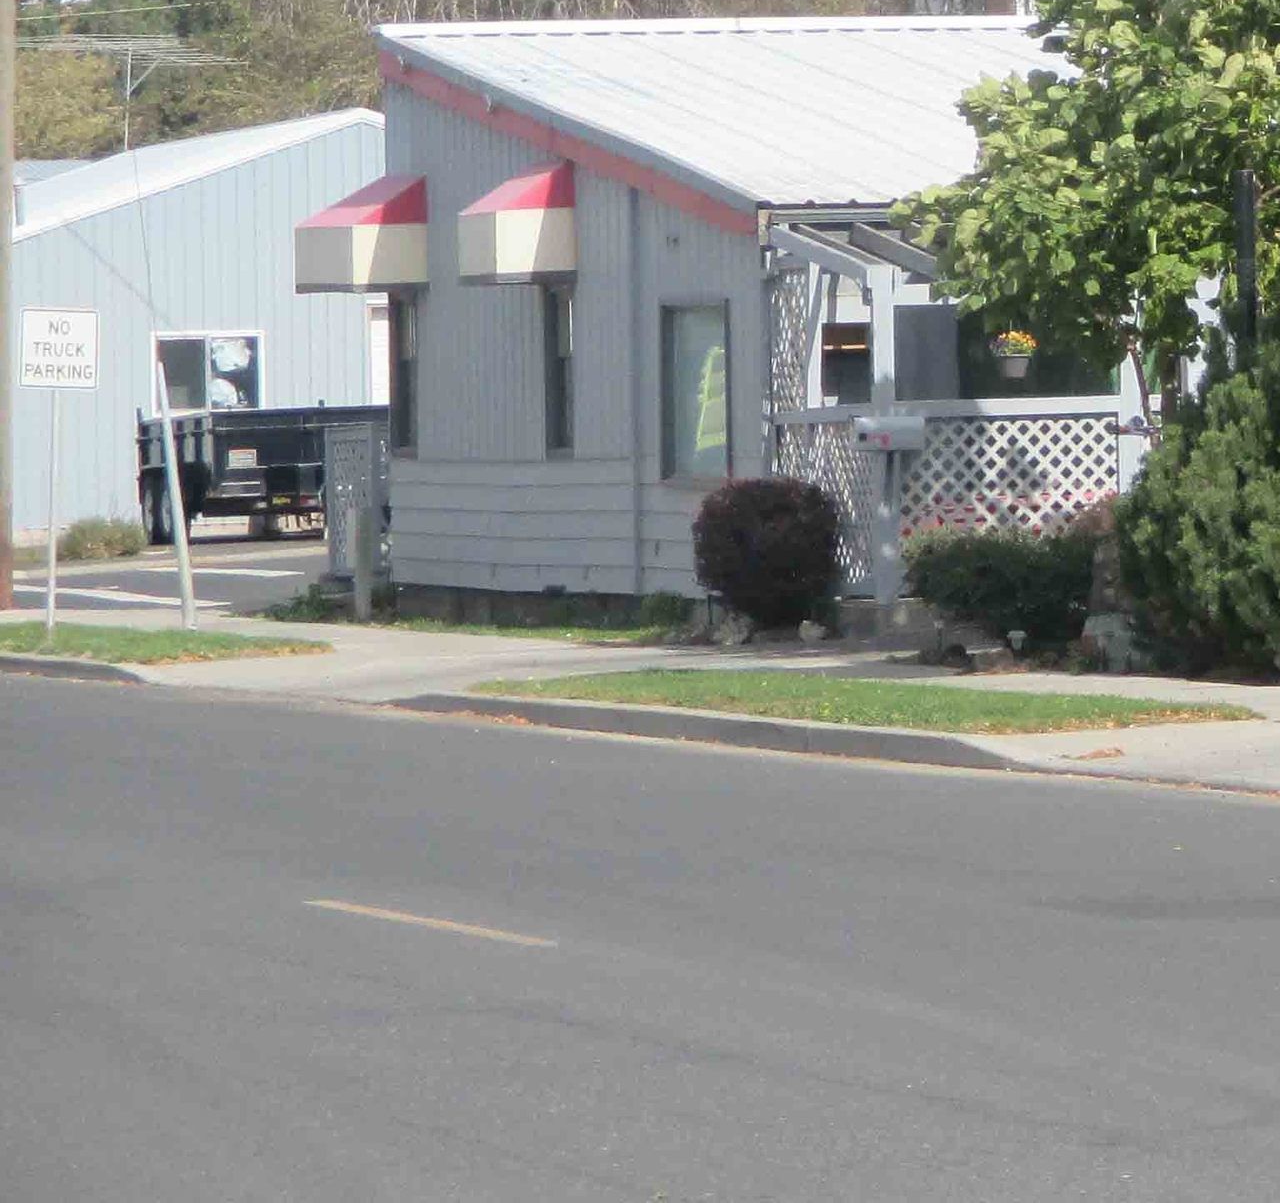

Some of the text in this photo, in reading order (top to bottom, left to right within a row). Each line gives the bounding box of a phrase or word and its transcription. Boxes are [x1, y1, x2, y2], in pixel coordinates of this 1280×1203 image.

[48, 320, 71, 335] NO
[33, 341, 85, 357] TRUCK
[24, 363, 93, 381] PARKING
